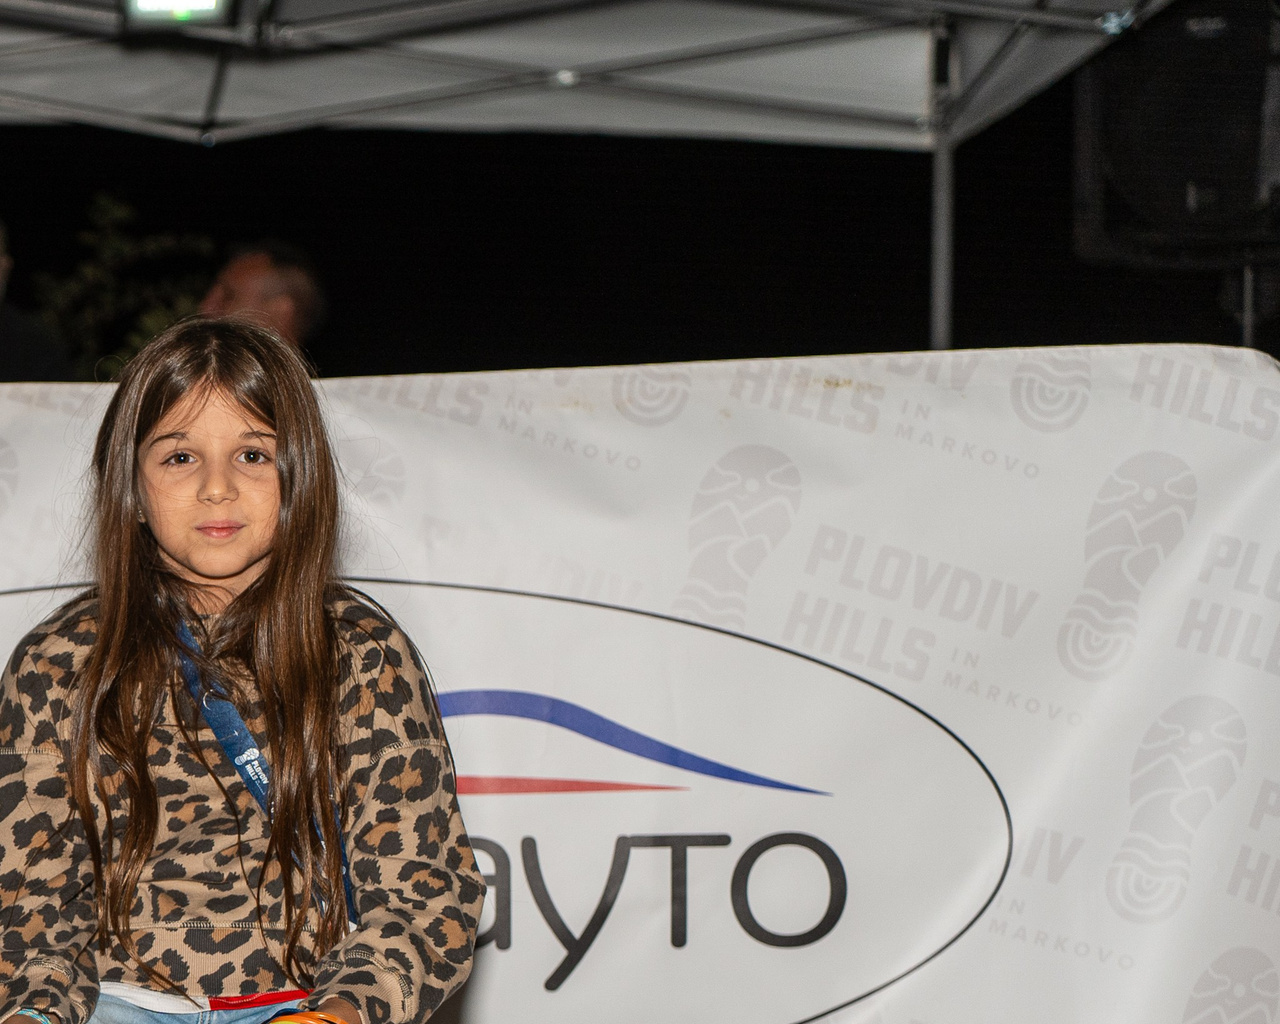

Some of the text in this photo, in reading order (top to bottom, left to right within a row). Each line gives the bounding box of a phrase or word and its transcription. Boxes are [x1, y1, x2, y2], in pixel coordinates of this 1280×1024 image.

[1129, 351, 1280, 441] HILLS
[497, 412, 642, 472] MARKOVO
[894, 424, 1040, 480] MARKOVO
[804, 524, 1040, 640] PLOVDIV
[781, 591, 937, 683] HILLS
[942, 647, 1085, 727] IN MARKOVO
[987, 918, 1135, 971] MARKOVO
